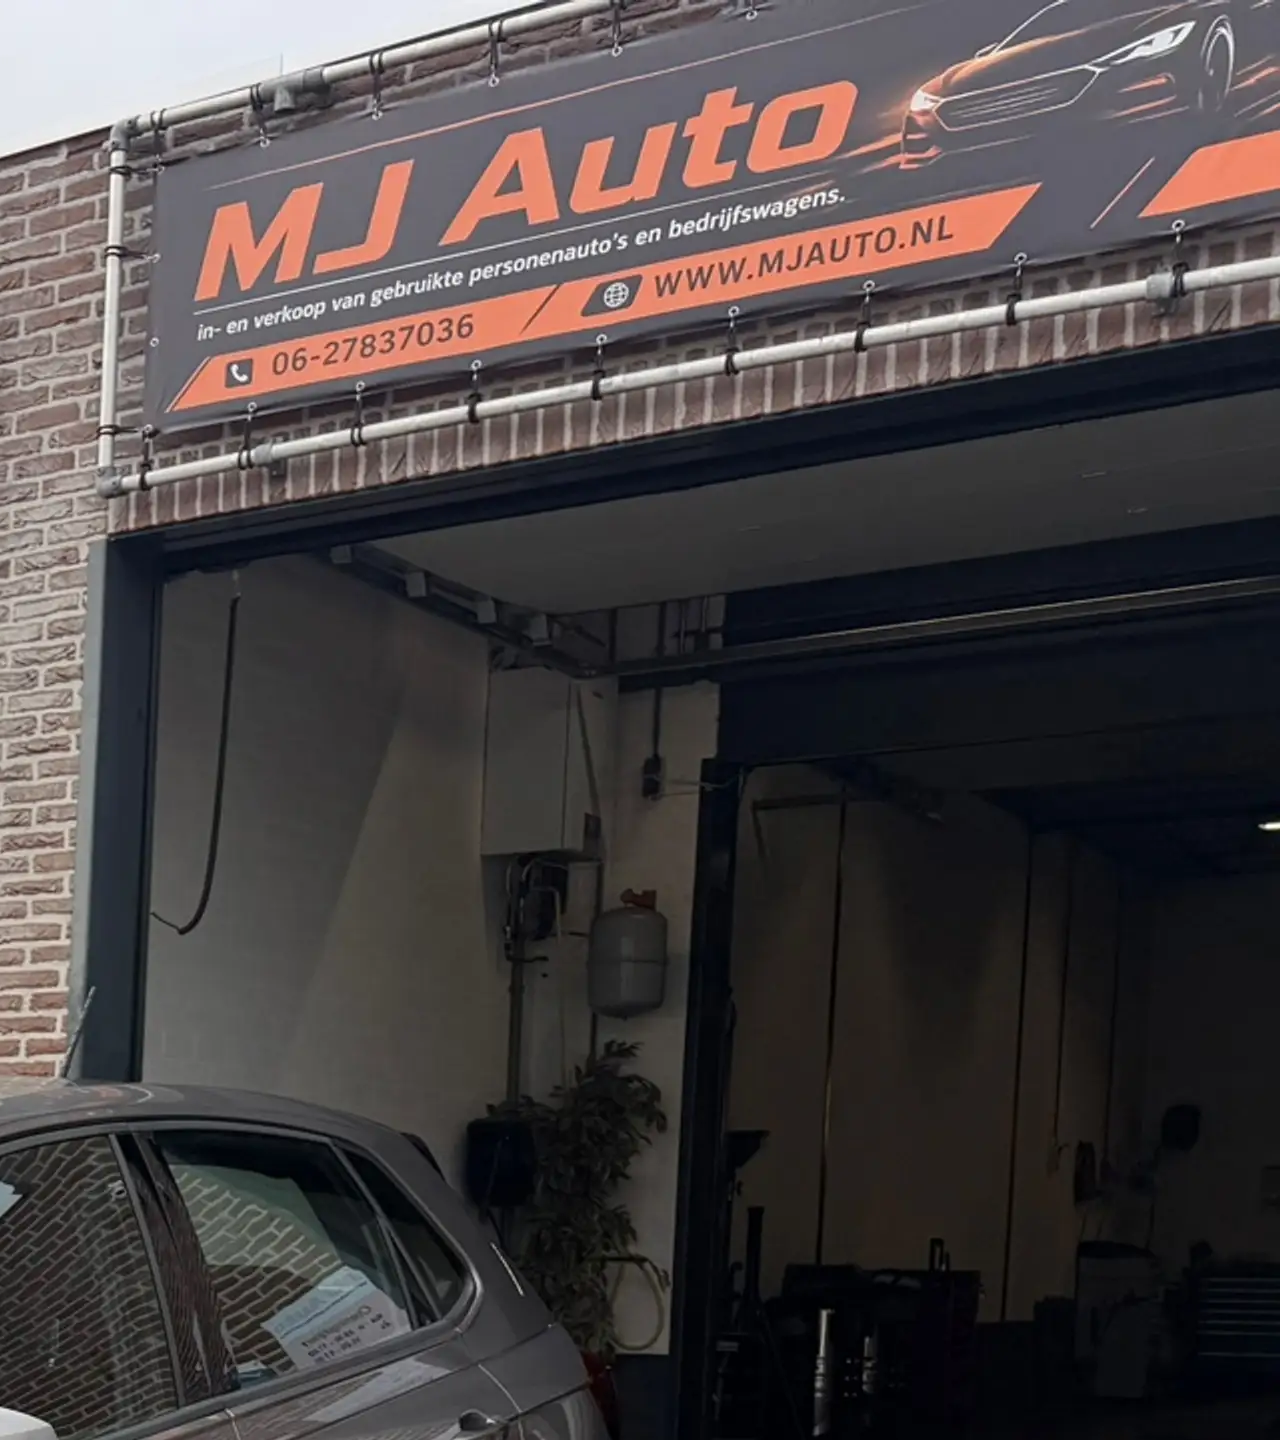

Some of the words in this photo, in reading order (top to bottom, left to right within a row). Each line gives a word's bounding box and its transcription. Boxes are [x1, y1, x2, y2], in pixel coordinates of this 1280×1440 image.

[194, 159, 414, 301] MJ
[438, 80, 858, 246] Auto
[197, 324, 222, 341] in-
[226, 318, 248, 335] en
[254, 302, 326, 327] verkoop
[332, 292, 365, 312] van
[370, 271, 463, 307] gebruikte
[468, 233, 628, 286] personenauto's
[635, 227, 661, 245] en
[668, 188, 845, 239] bedrijfswagens.
[654, 215, 953, 297] WWW.MJAUTO.NL
[272, 314, 474, 375] 06-27837036
